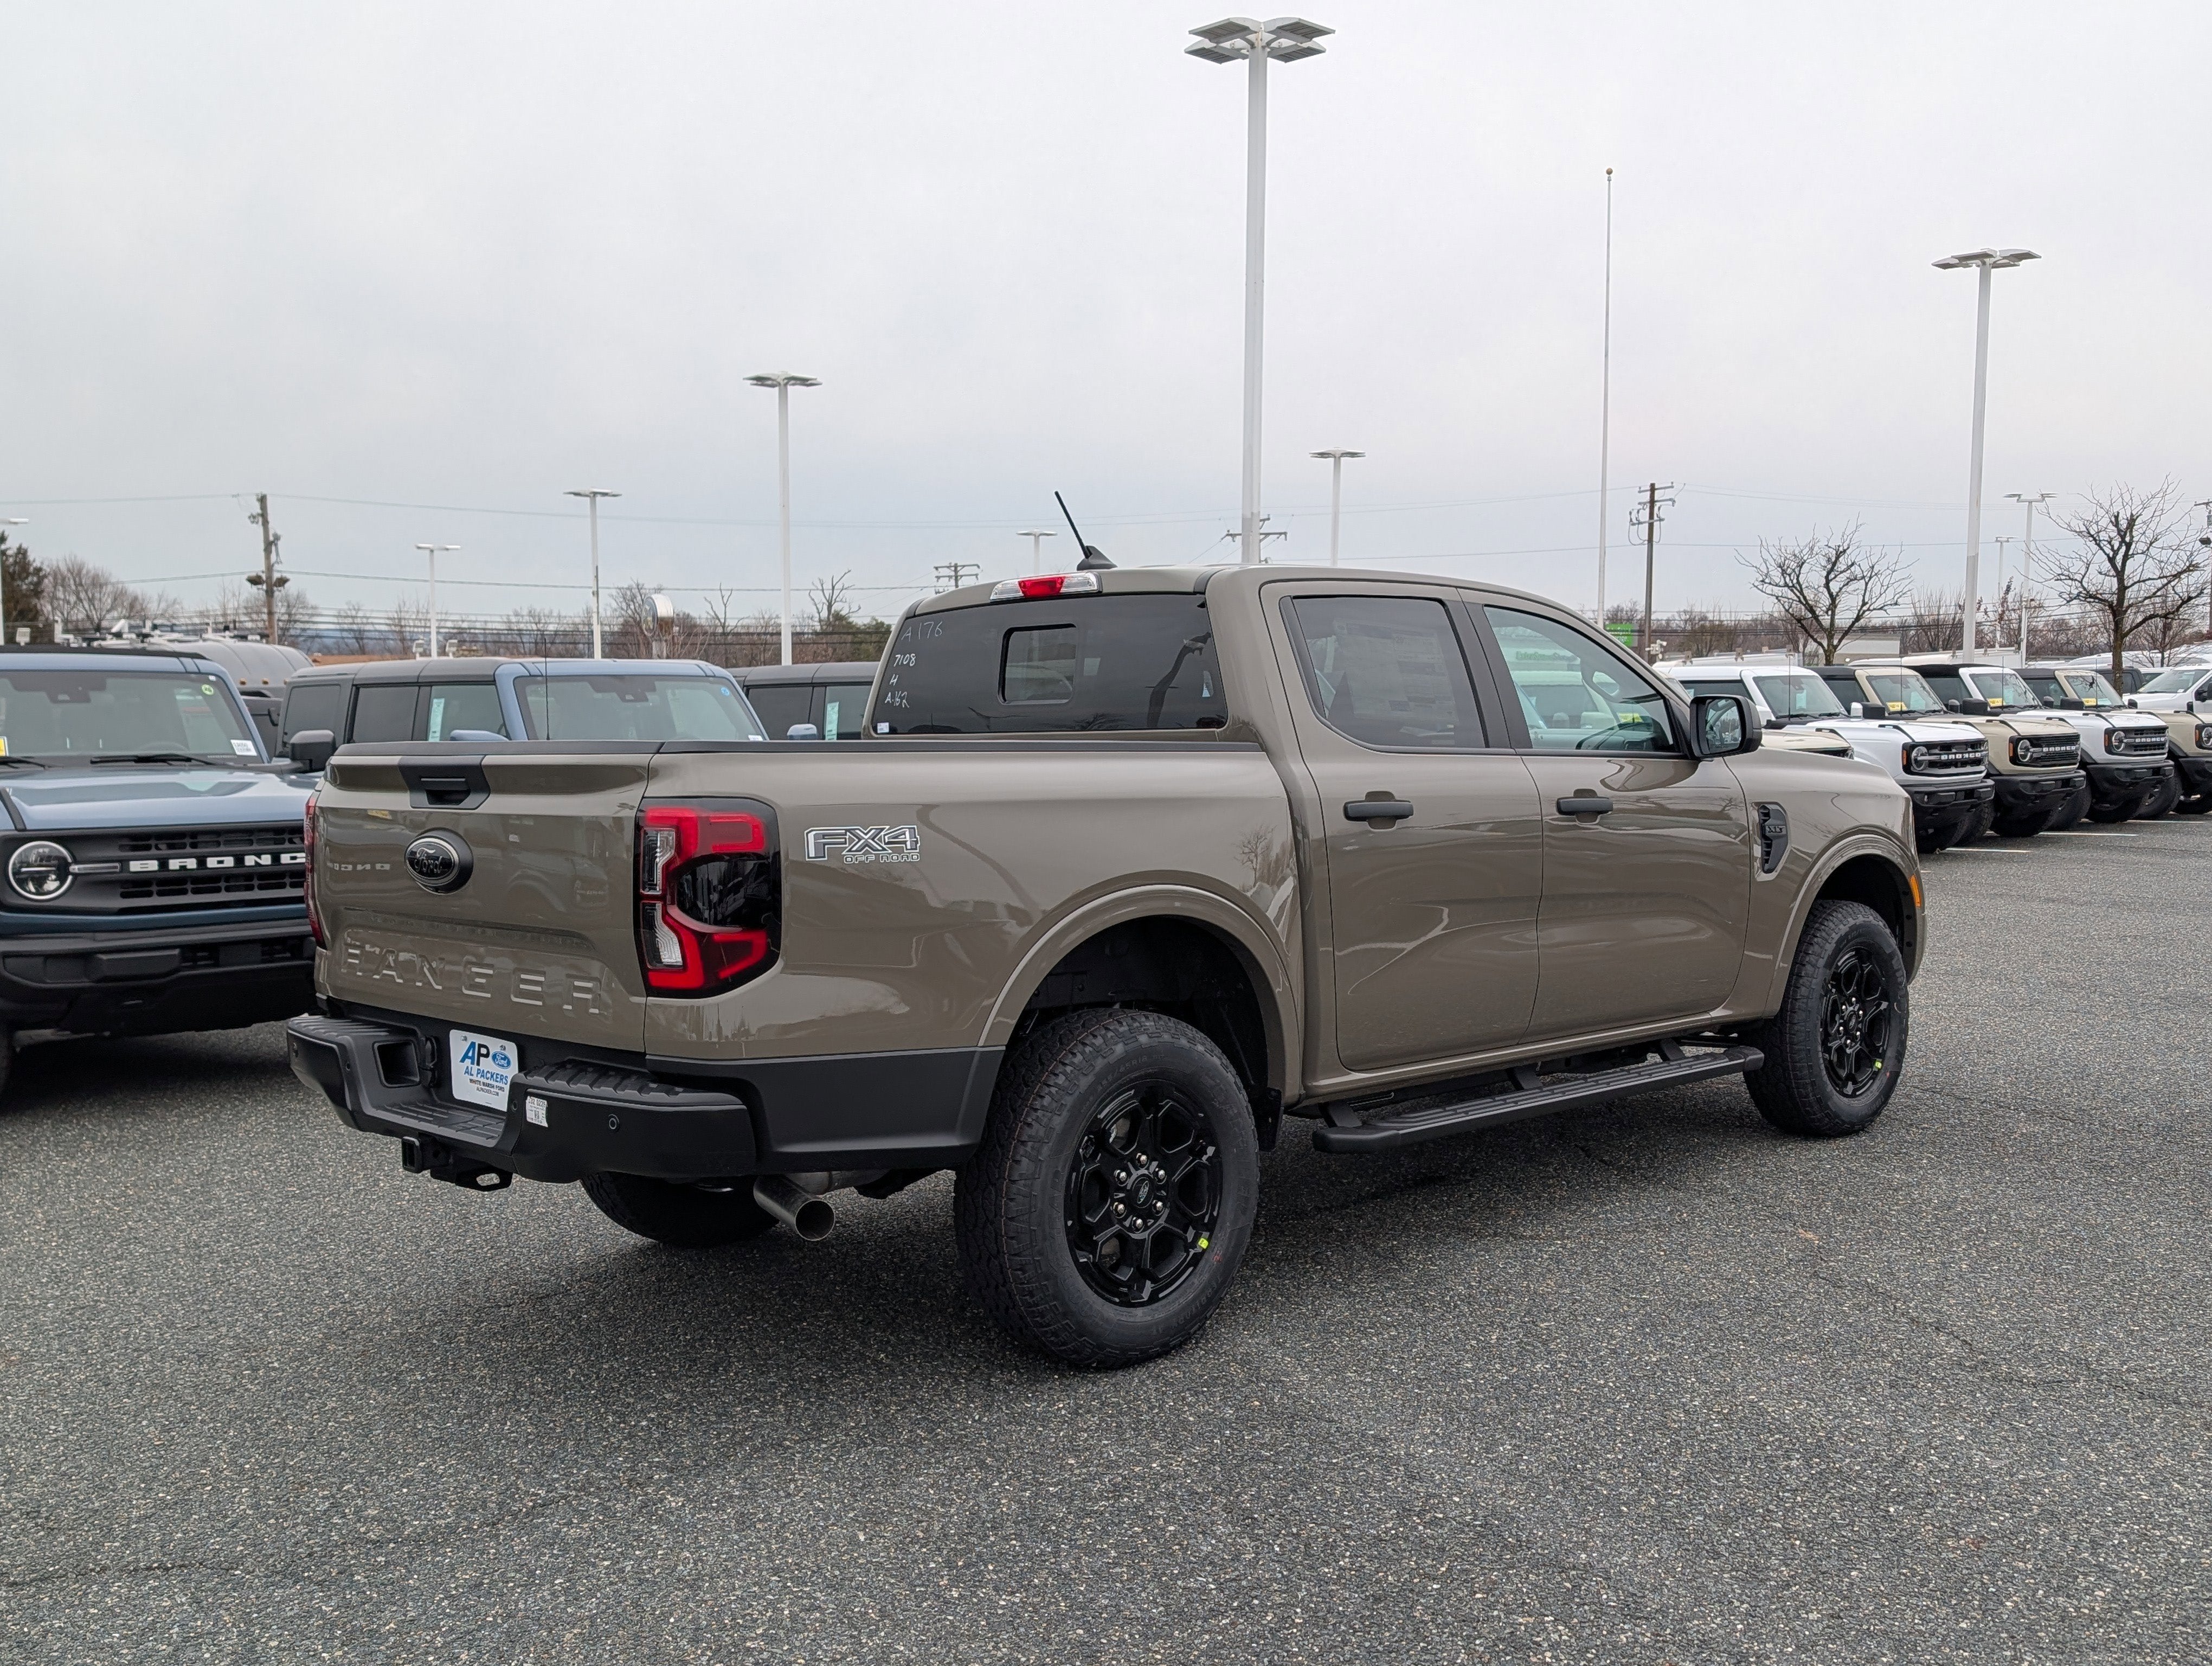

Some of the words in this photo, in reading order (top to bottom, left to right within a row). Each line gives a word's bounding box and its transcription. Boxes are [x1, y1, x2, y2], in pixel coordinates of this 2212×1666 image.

[893, 653, 916, 667] 7108
[805, 825, 920, 861] FX4
[129, 853, 306, 873] BRONC
[414, 847, 448, 874] Ford
[844, 854, 876, 864] OFF
[879, 853, 920, 863] ROAD
[342, 943, 602, 1014] RANGER
[459, 1041, 490, 1067] AP
[464, 1066, 474, 1077] AL
[476, 1068, 509, 1085] PACKERS
